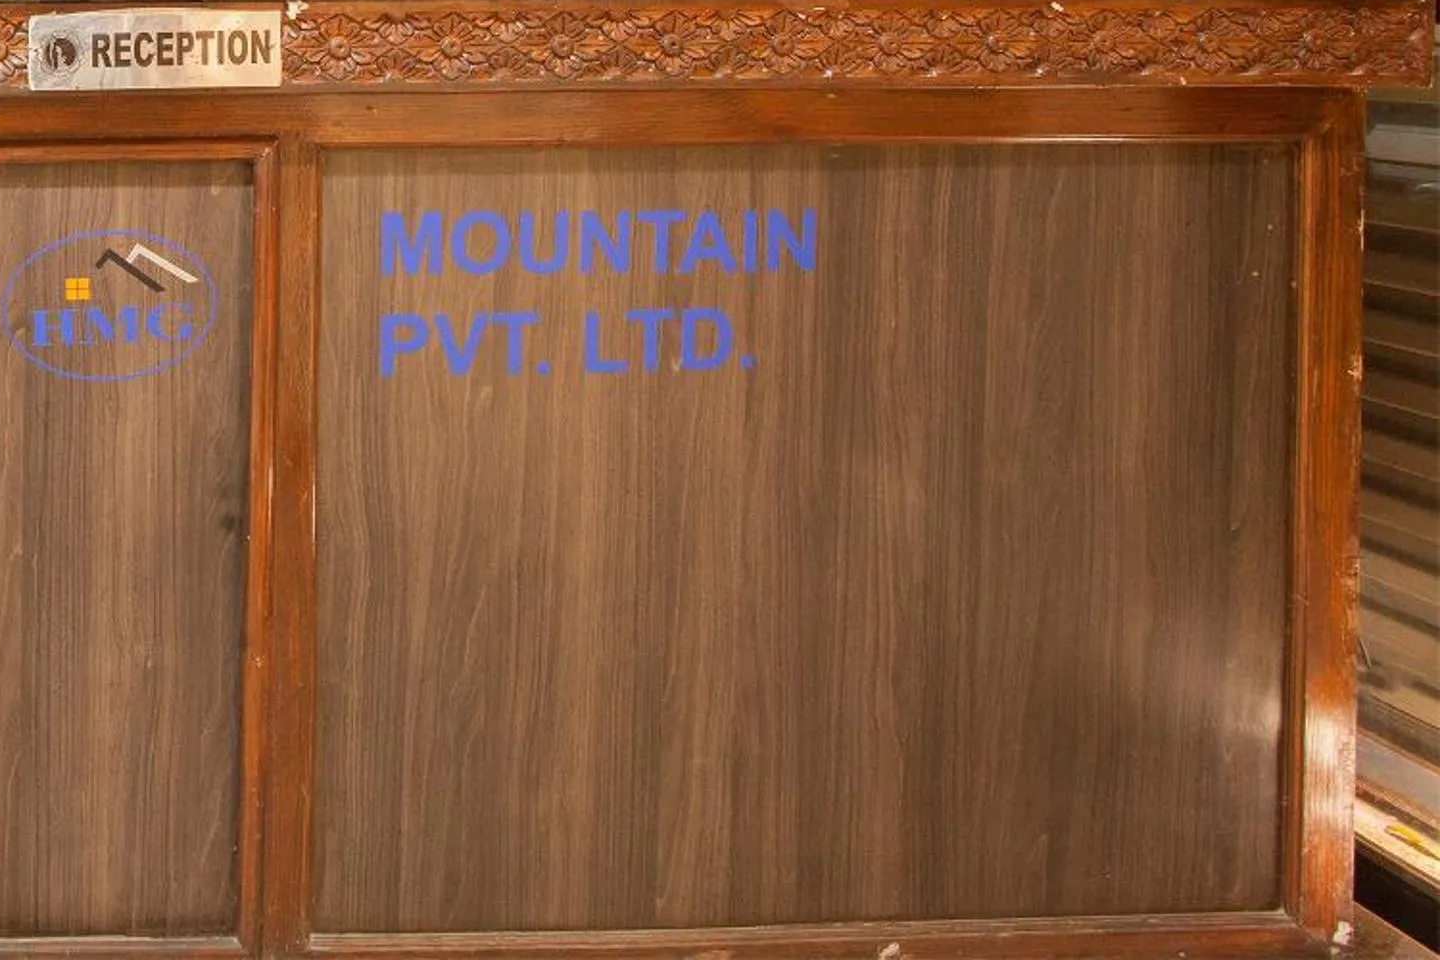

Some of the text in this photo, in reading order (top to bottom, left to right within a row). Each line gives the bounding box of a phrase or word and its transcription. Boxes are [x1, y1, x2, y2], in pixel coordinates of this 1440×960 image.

[90, 29, 272, 69] RECEPTION
[379, 207, 818, 277] MOUNTAIN
[31, 302, 194, 348] HMG
[378, 306, 757, 378] PVT. LTD.
